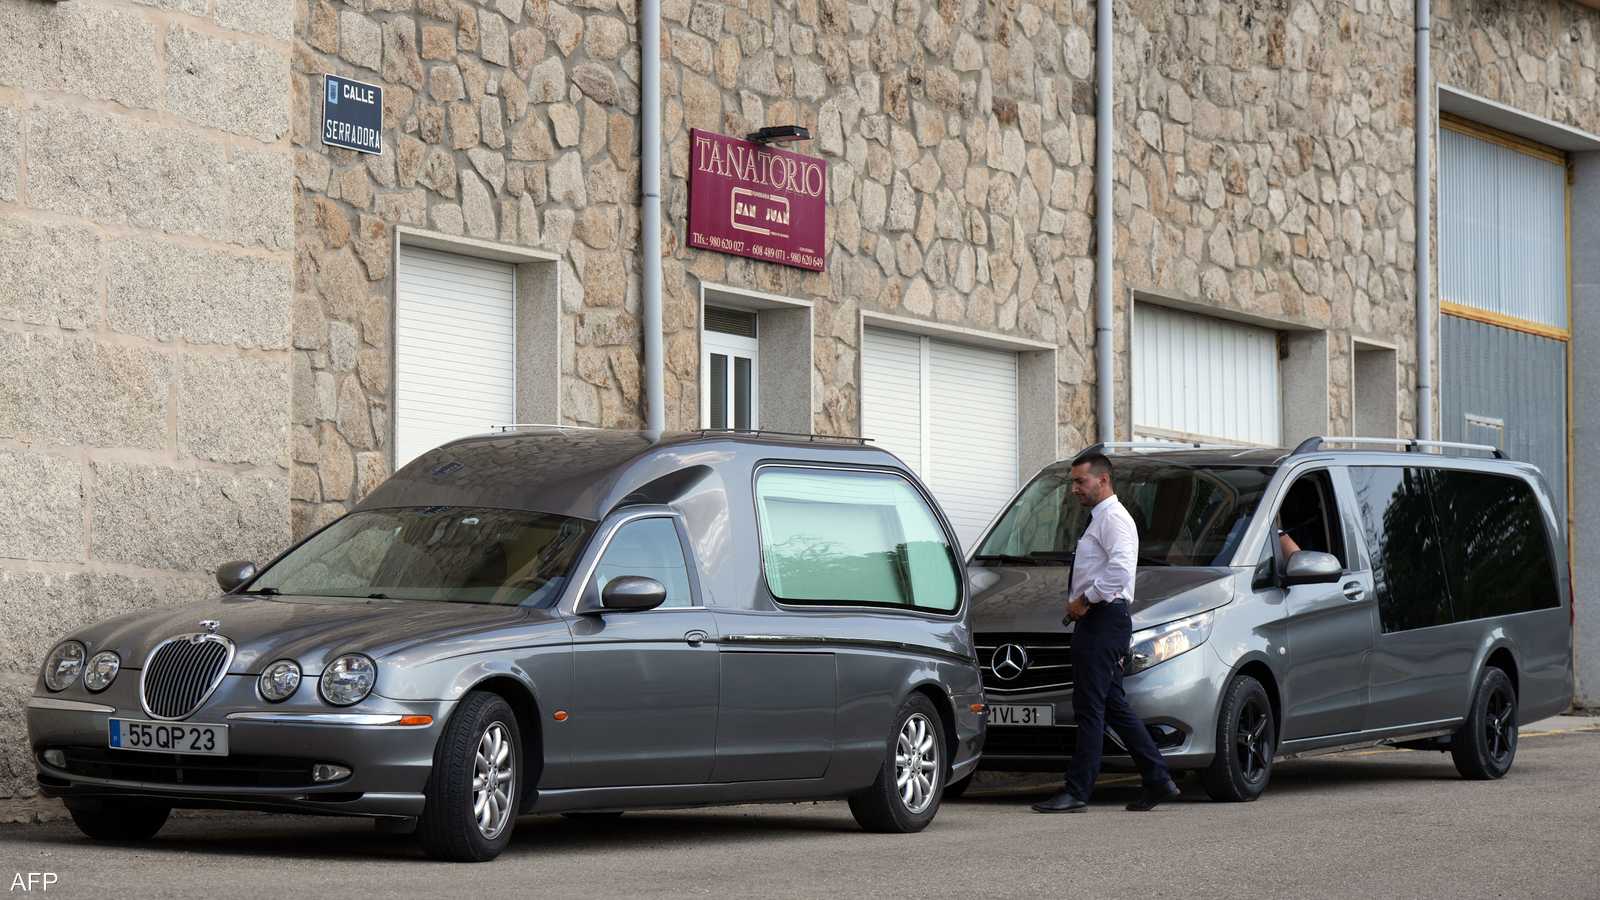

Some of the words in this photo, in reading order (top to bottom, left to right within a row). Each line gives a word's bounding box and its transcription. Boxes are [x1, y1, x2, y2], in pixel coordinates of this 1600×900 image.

[343, 84, 375, 104] CALLE
[326, 119, 380, 149] SERRADORA
[696, 136, 822, 197] TANATORIO
[735, 202, 756, 218] SAN
[765, 207, 790, 226] JUAN
[709, 236, 720, 248] 980
[721, 238, 732, 250] 620
[733, 240, 744, 252] 027
[752, 244, 763, 256] 608
[801, 254, 812, 266] 620
[813, 256, 824, 267] 649
